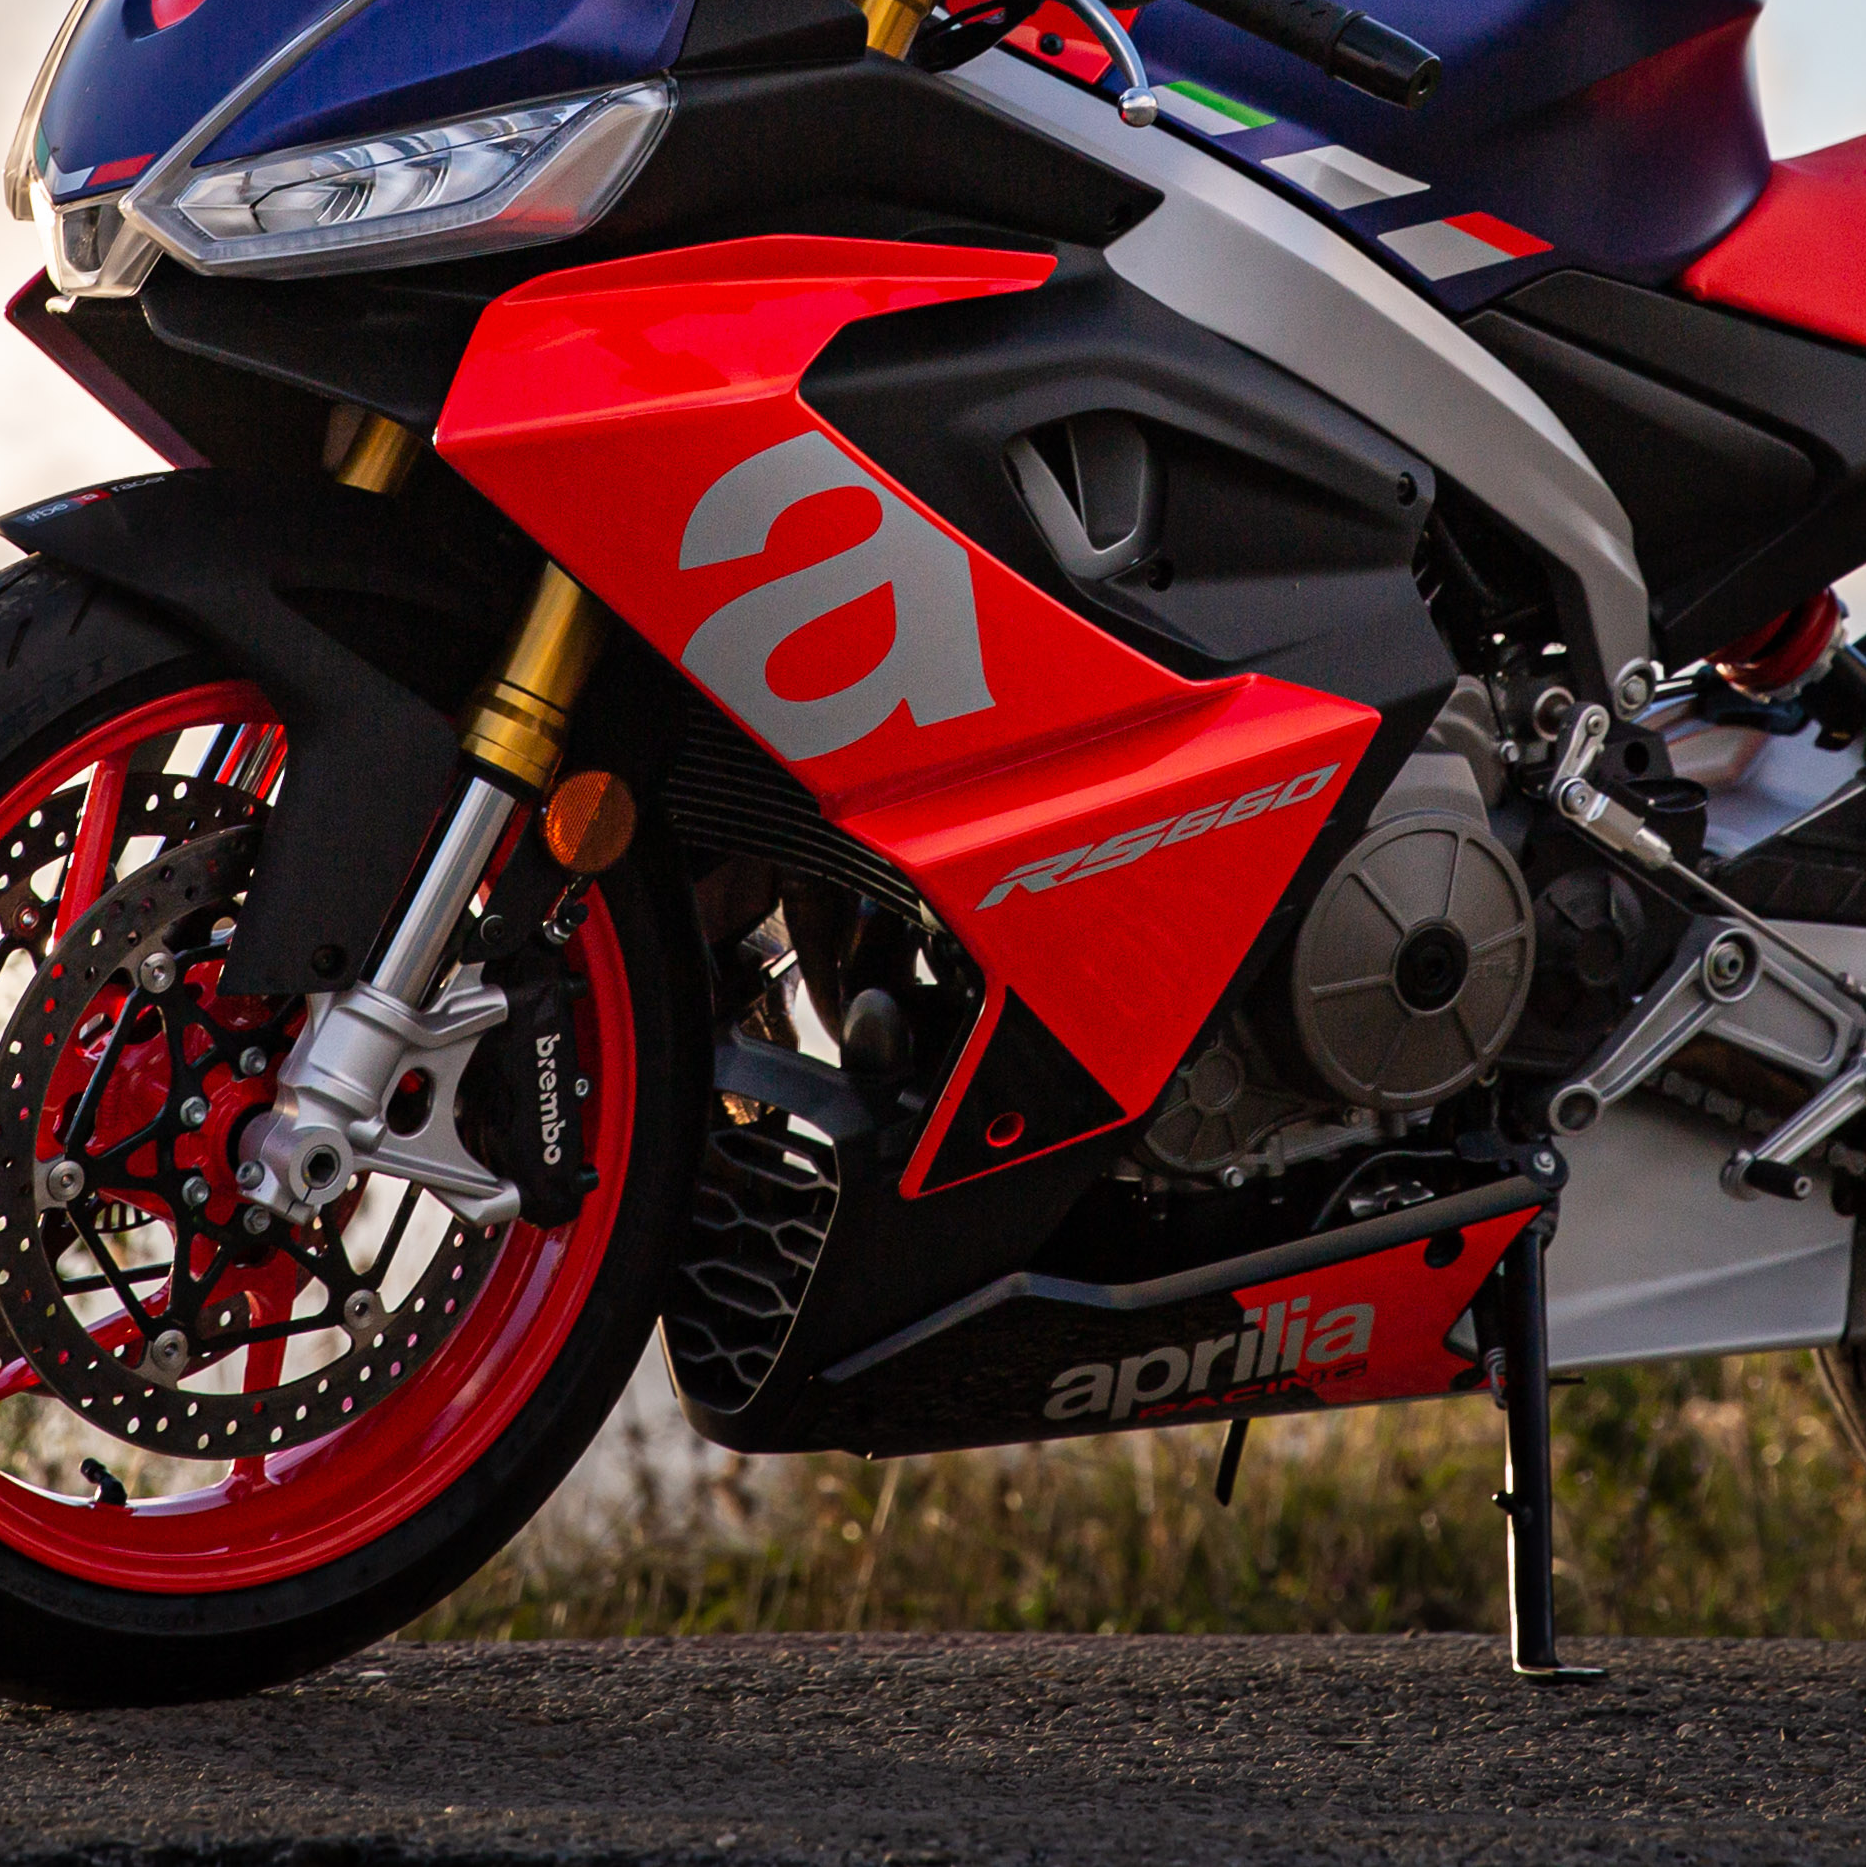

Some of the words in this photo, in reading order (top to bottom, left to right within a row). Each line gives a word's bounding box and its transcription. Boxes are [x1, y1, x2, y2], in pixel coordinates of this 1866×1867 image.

[26, 502, 69, 523] #be
[110, 475, 165, 493] racer
[679, 429, 996, 762] a
[974, 762, 1341, 912] RS660
[536, 1033, 566, 1165] brembo
[1043, 1295, 1376, 1420] aprilia
[1138, 1359, 1368, 1420] RACING
